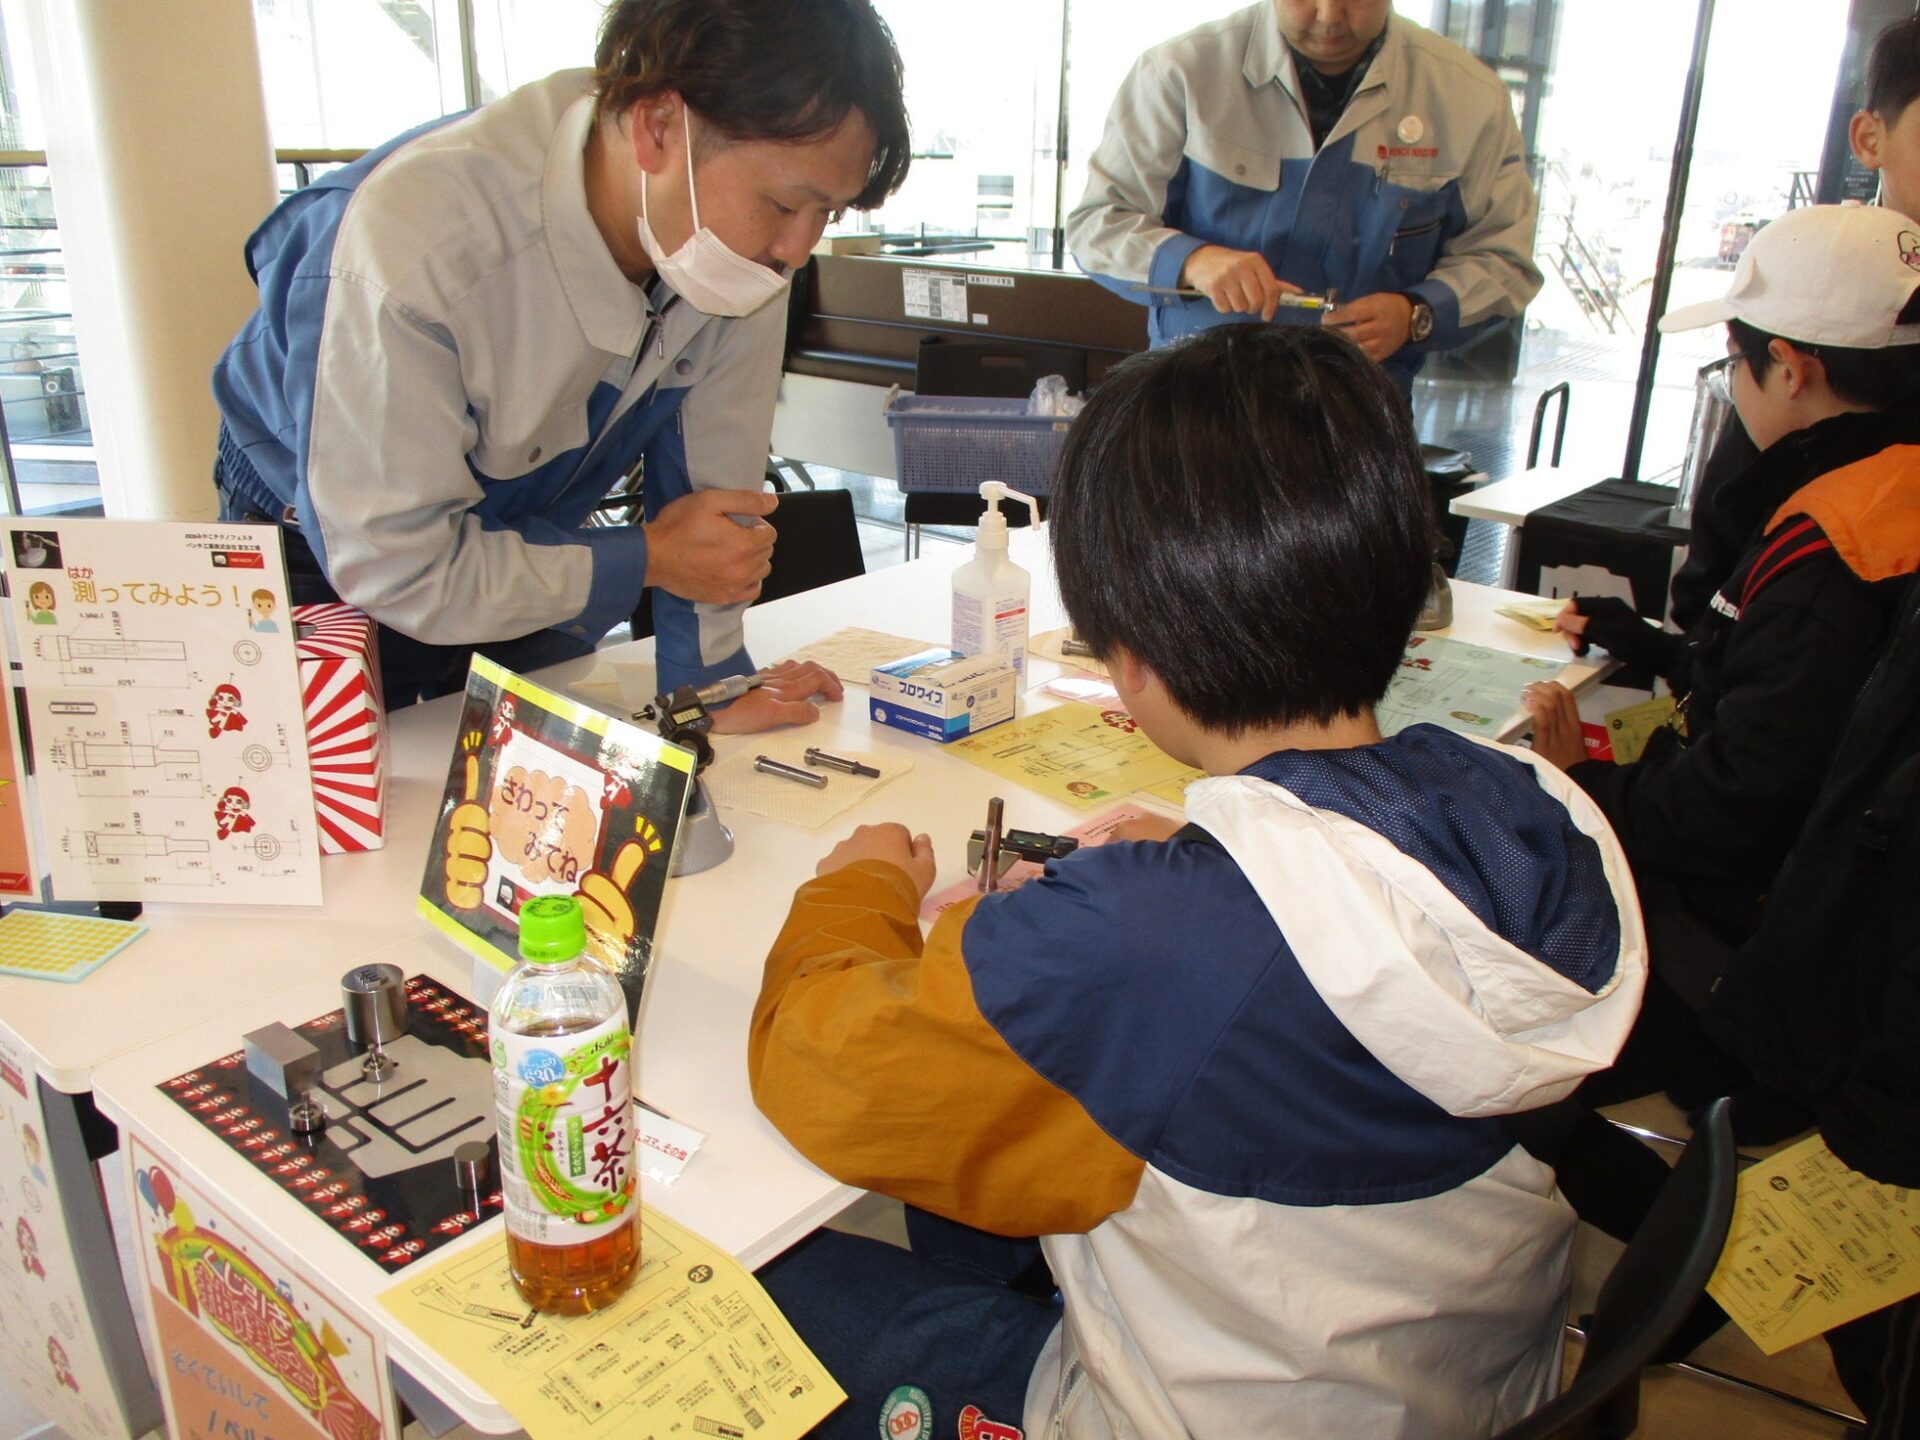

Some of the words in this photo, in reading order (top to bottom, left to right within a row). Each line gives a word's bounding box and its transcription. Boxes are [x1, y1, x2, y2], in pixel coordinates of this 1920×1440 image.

[67, 566, 94, 580] はか
[72, 580, 240, 608] 測ってみよう！
[583, 1058, 631, 1193] 十六茶
[690, 1265, 711, 1282] 2F
